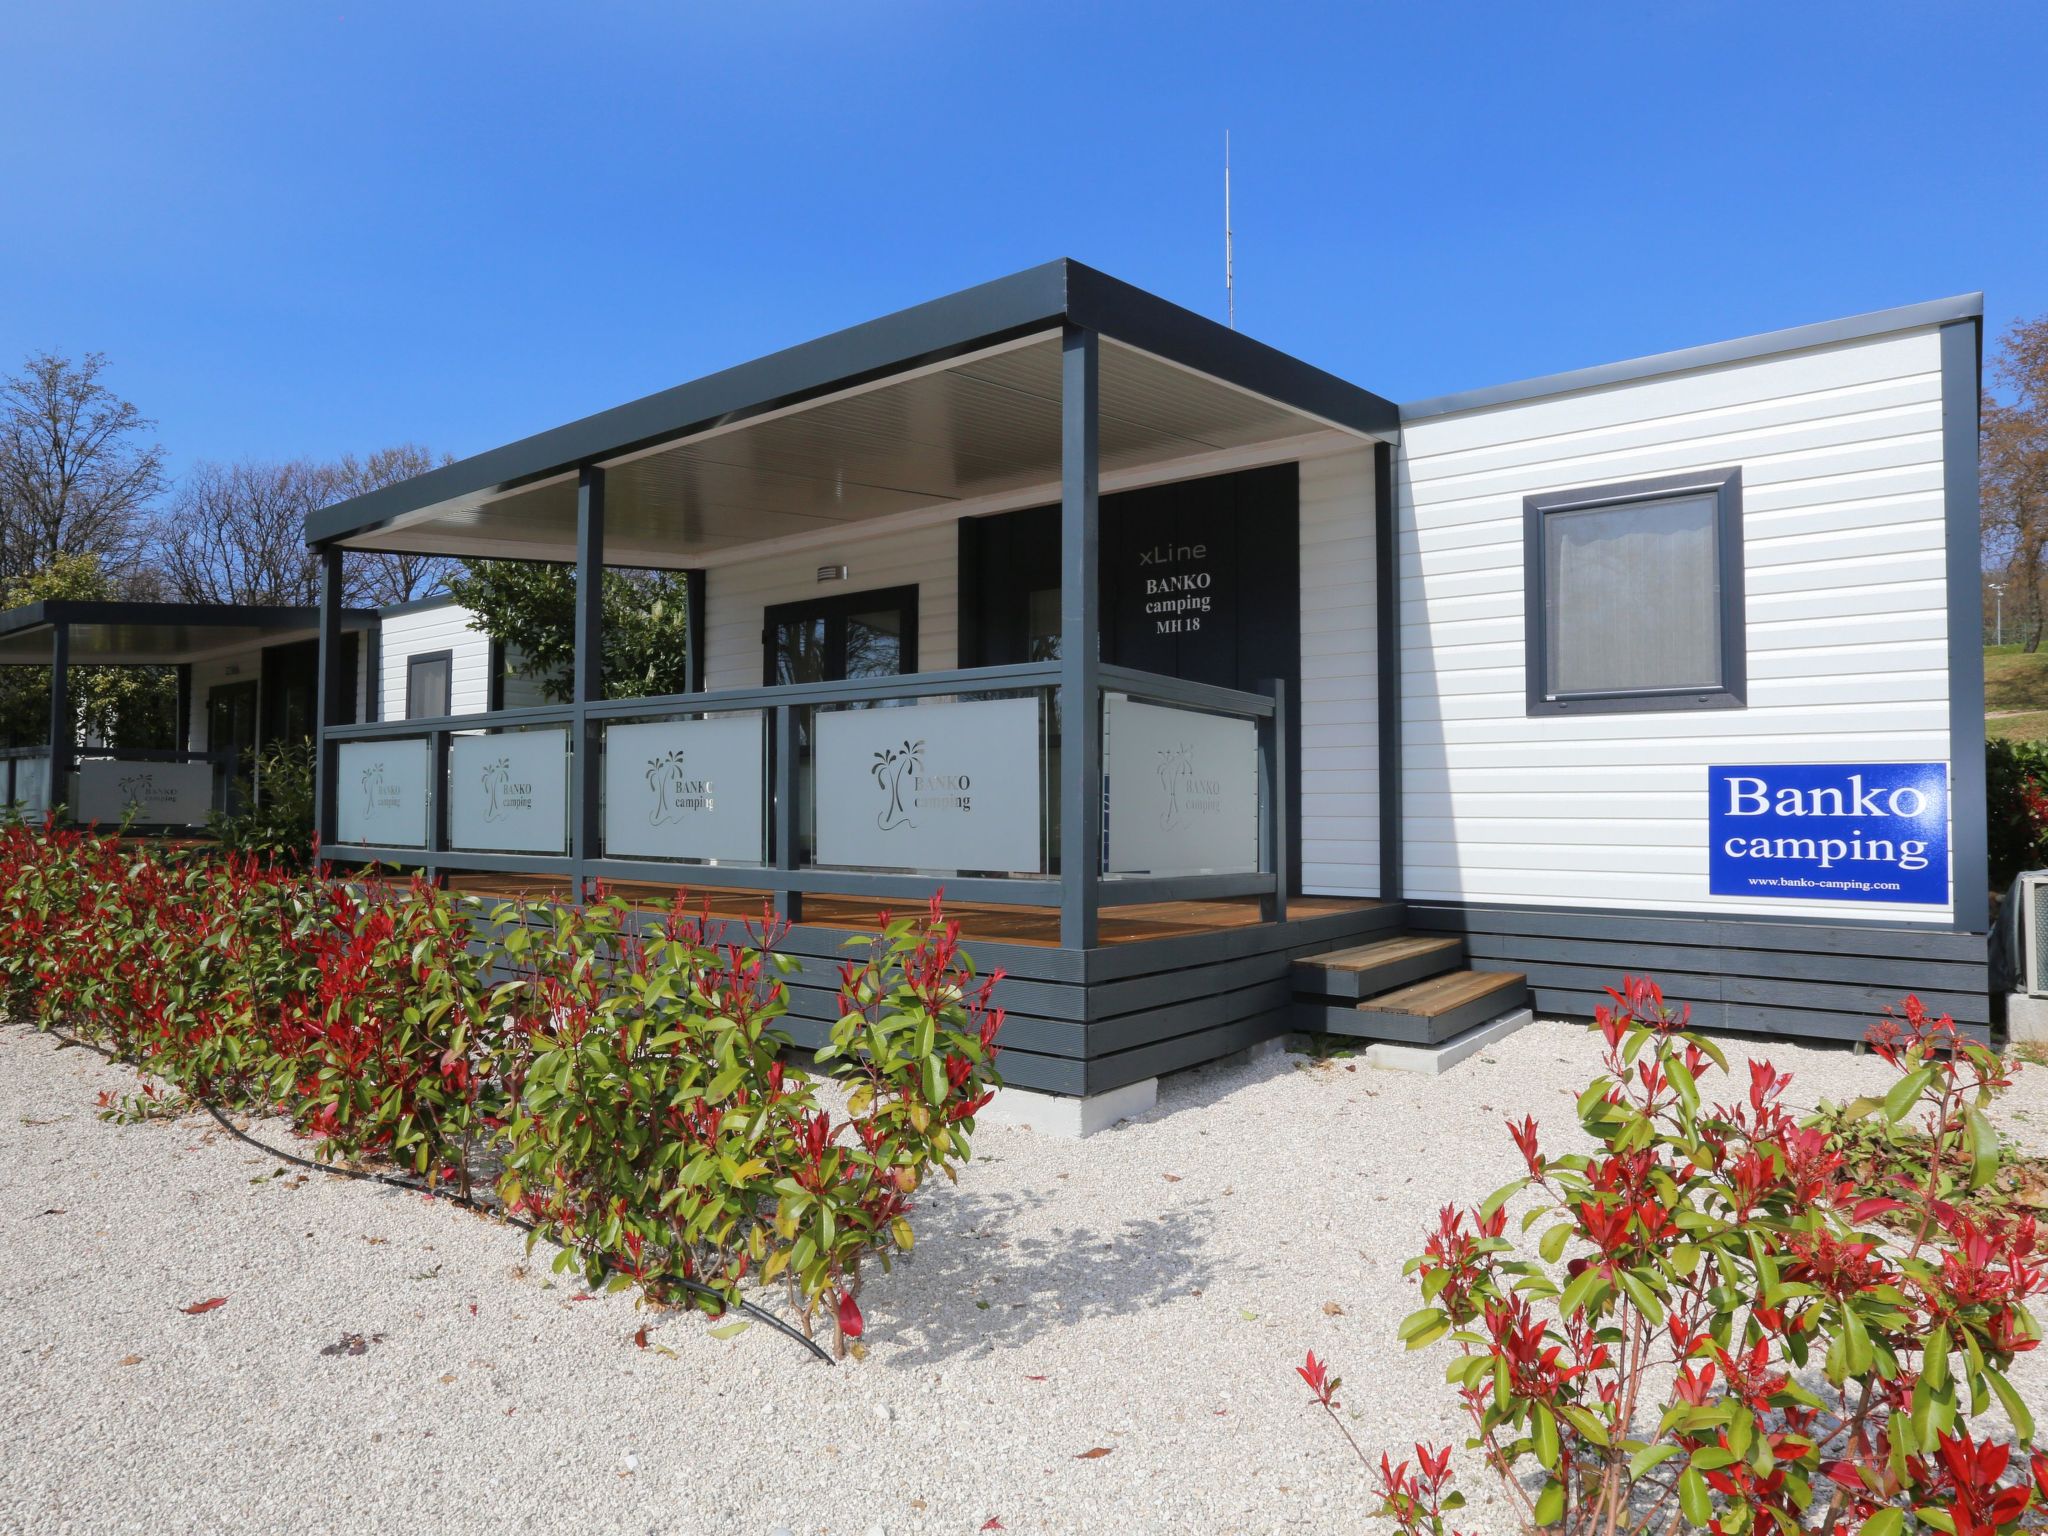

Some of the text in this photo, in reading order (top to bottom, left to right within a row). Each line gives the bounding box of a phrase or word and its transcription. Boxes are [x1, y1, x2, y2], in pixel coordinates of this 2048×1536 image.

[1139, 543, 1207, 566] xLine
[1146, 572, 1211, 594] BANKO
[1145, 594, 1211, 614] camping
[1156, 617, 1200, 634] MH 18
[503, 783, 532, 795] BANKO
[914, 775, 970, 791] BANKO
[1186, 778, 1220, 794] BANKO
[503, 795, 532, 810] camping
[675, 795, 714, 812] camping
[914, 794, 971, 812] camping
[1723, 774, 1927, 818] Banko
[1724, 829, 1929, 870] camping
[1748, 876, 1901, 891] www.banko-camping.com
